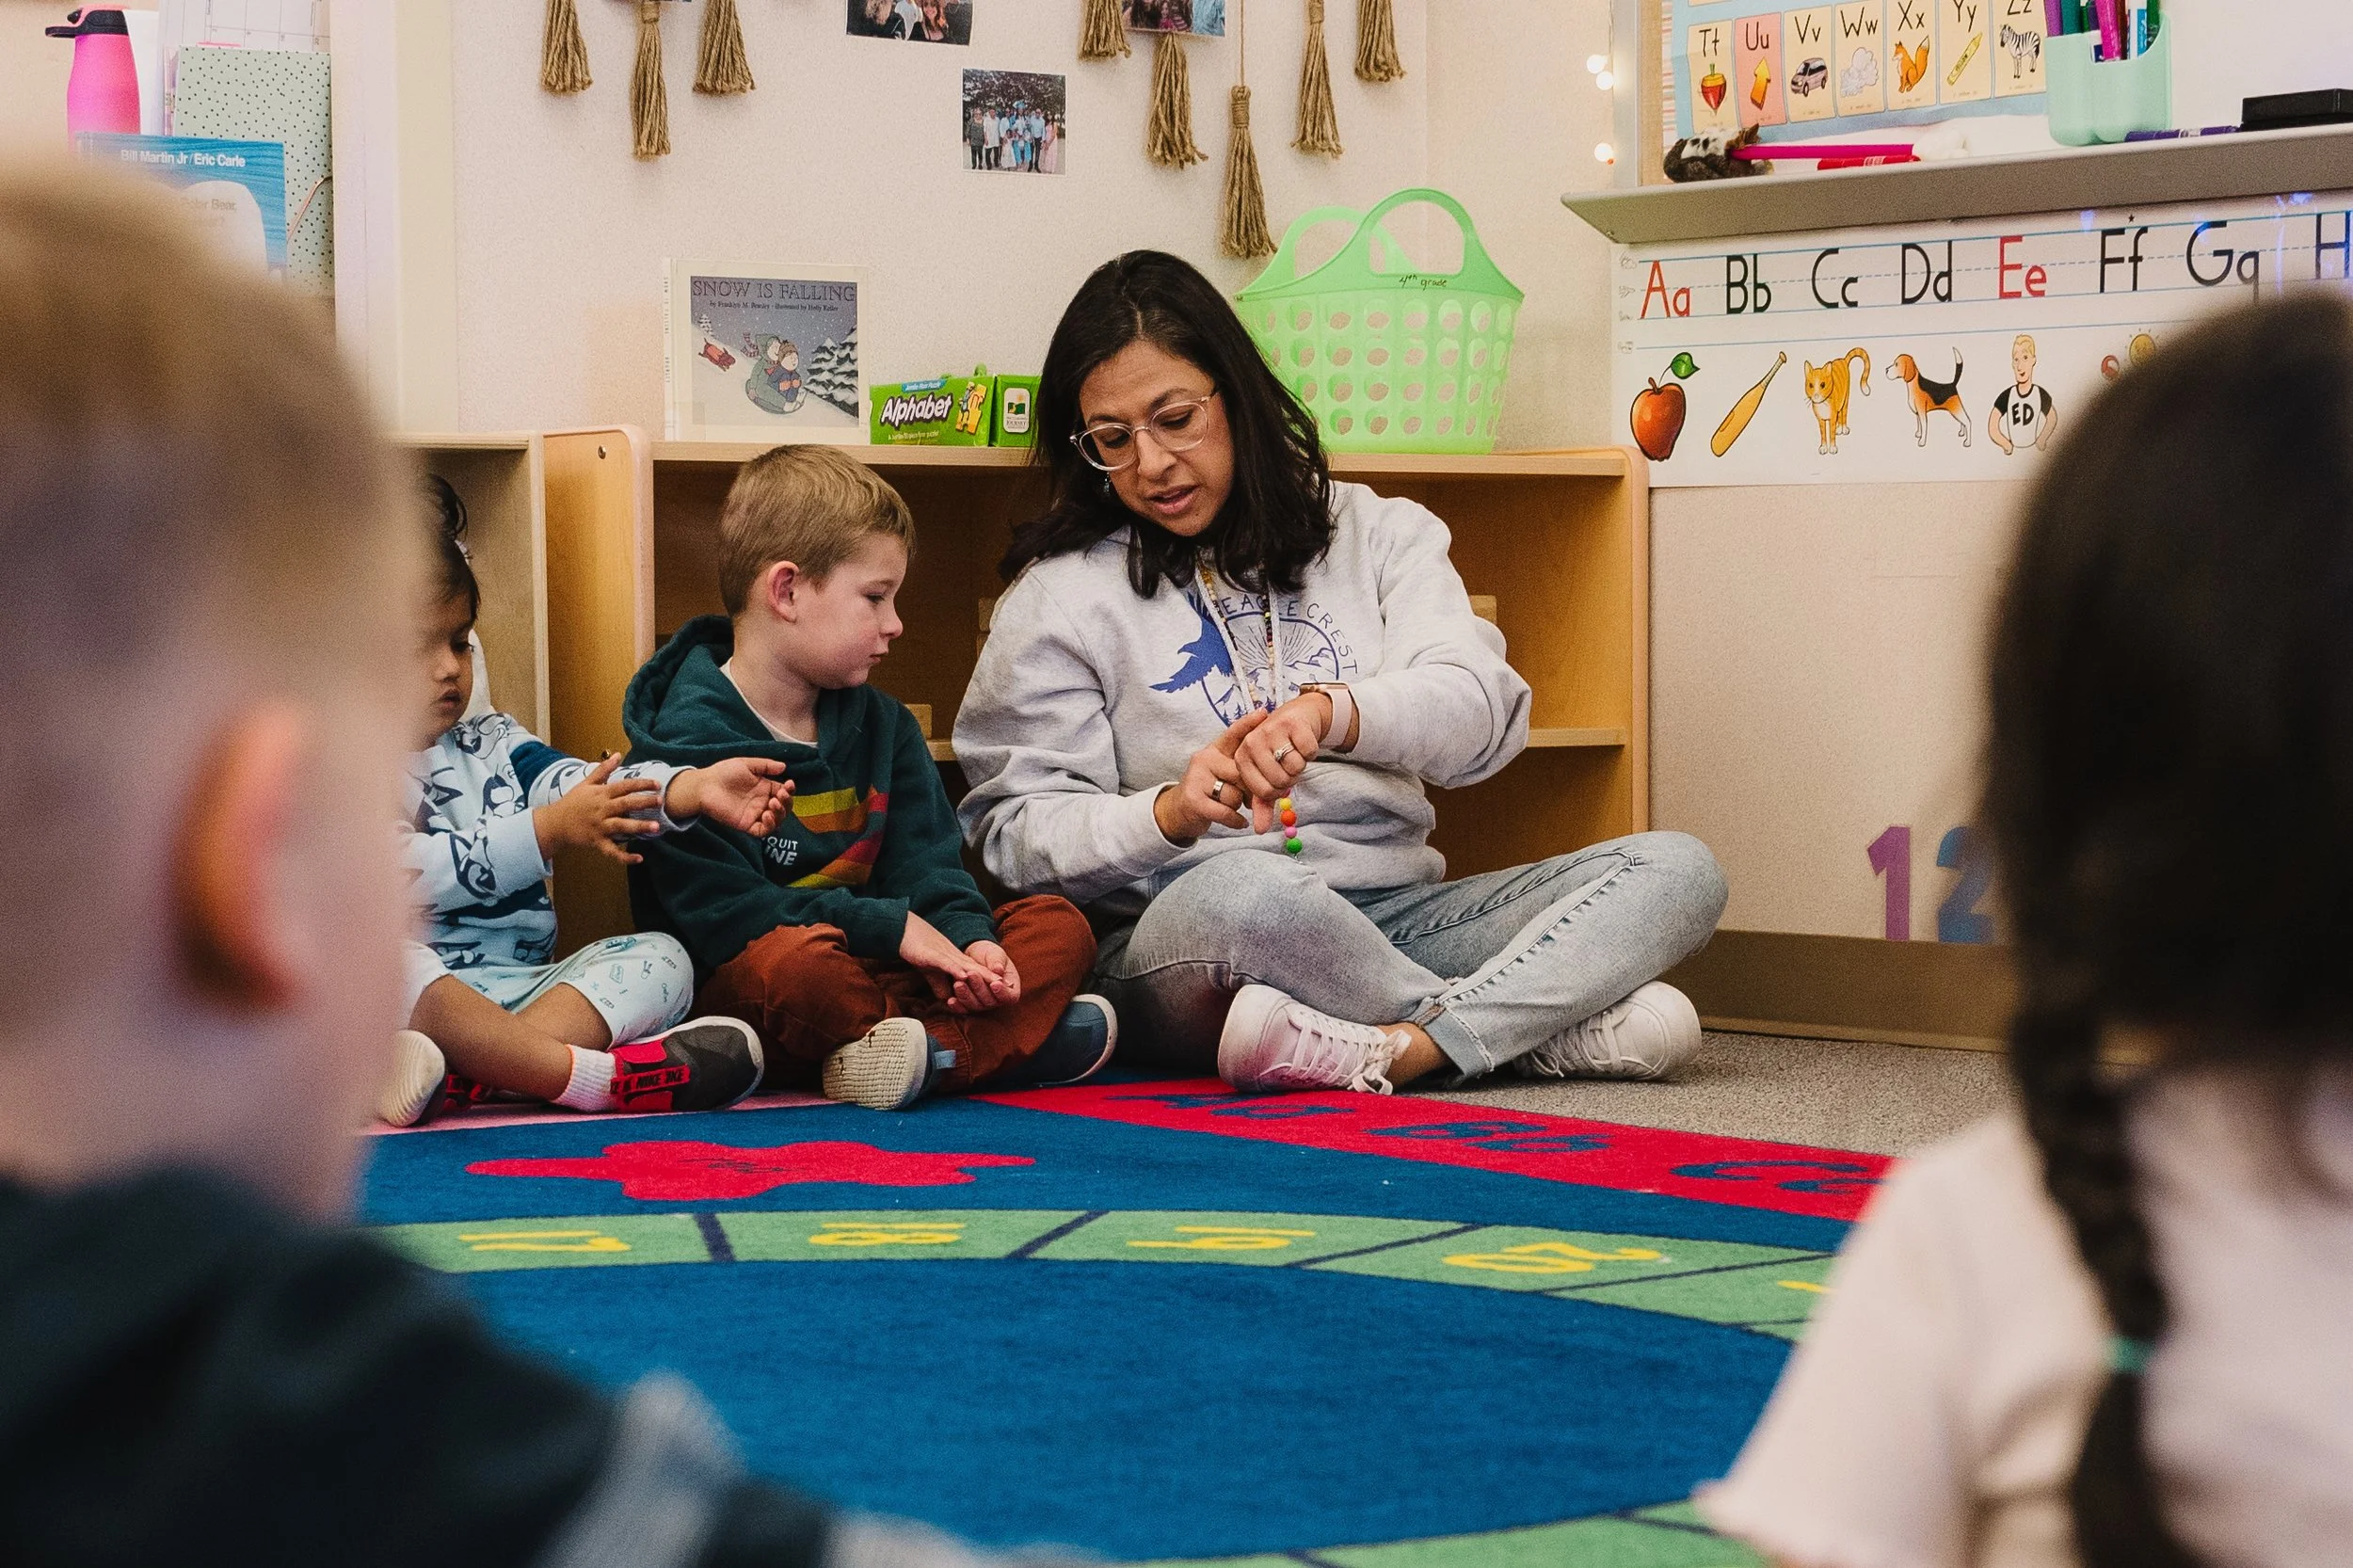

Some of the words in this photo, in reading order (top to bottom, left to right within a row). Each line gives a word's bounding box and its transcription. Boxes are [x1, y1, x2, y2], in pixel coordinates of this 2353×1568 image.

[1698, 27, 1721, 57] Tt
[1745, 21, 1769, 51] Uu
[1794, 13, 1821, 44] Vv
[1840, 7, 1879, 38] Ww
[1897, 0, 1925, 32] Xx
[120, 150, 138, 164] Bill
[141, 150, 175, 165] Martin
[176, 152, 188, 165] Jr
[194, 152, 216, 167] Eric
[216, 153, 246, 168] Carle
[1640, 260, 1691, 319] Aa
[1725, 253, 1772, 314] Bb
[1811, 248, 1859, 309] Cc
[1900, 240, 1953, 305] Dd
[1998, 235, 2048, 300] Ee
[2099, 226, 2149, 294] Ff
[692, 280, 751, 297] SNOW
[757, 282, 774, 299] IS
[779, 283, 856, 302] FALLING
[881, 392, 952, 428] Alphabet
[2010, 402, 2035, 426] ED
[1867, 825, 1911, 942] 1
[1935, 825, 1997, 945] 2
